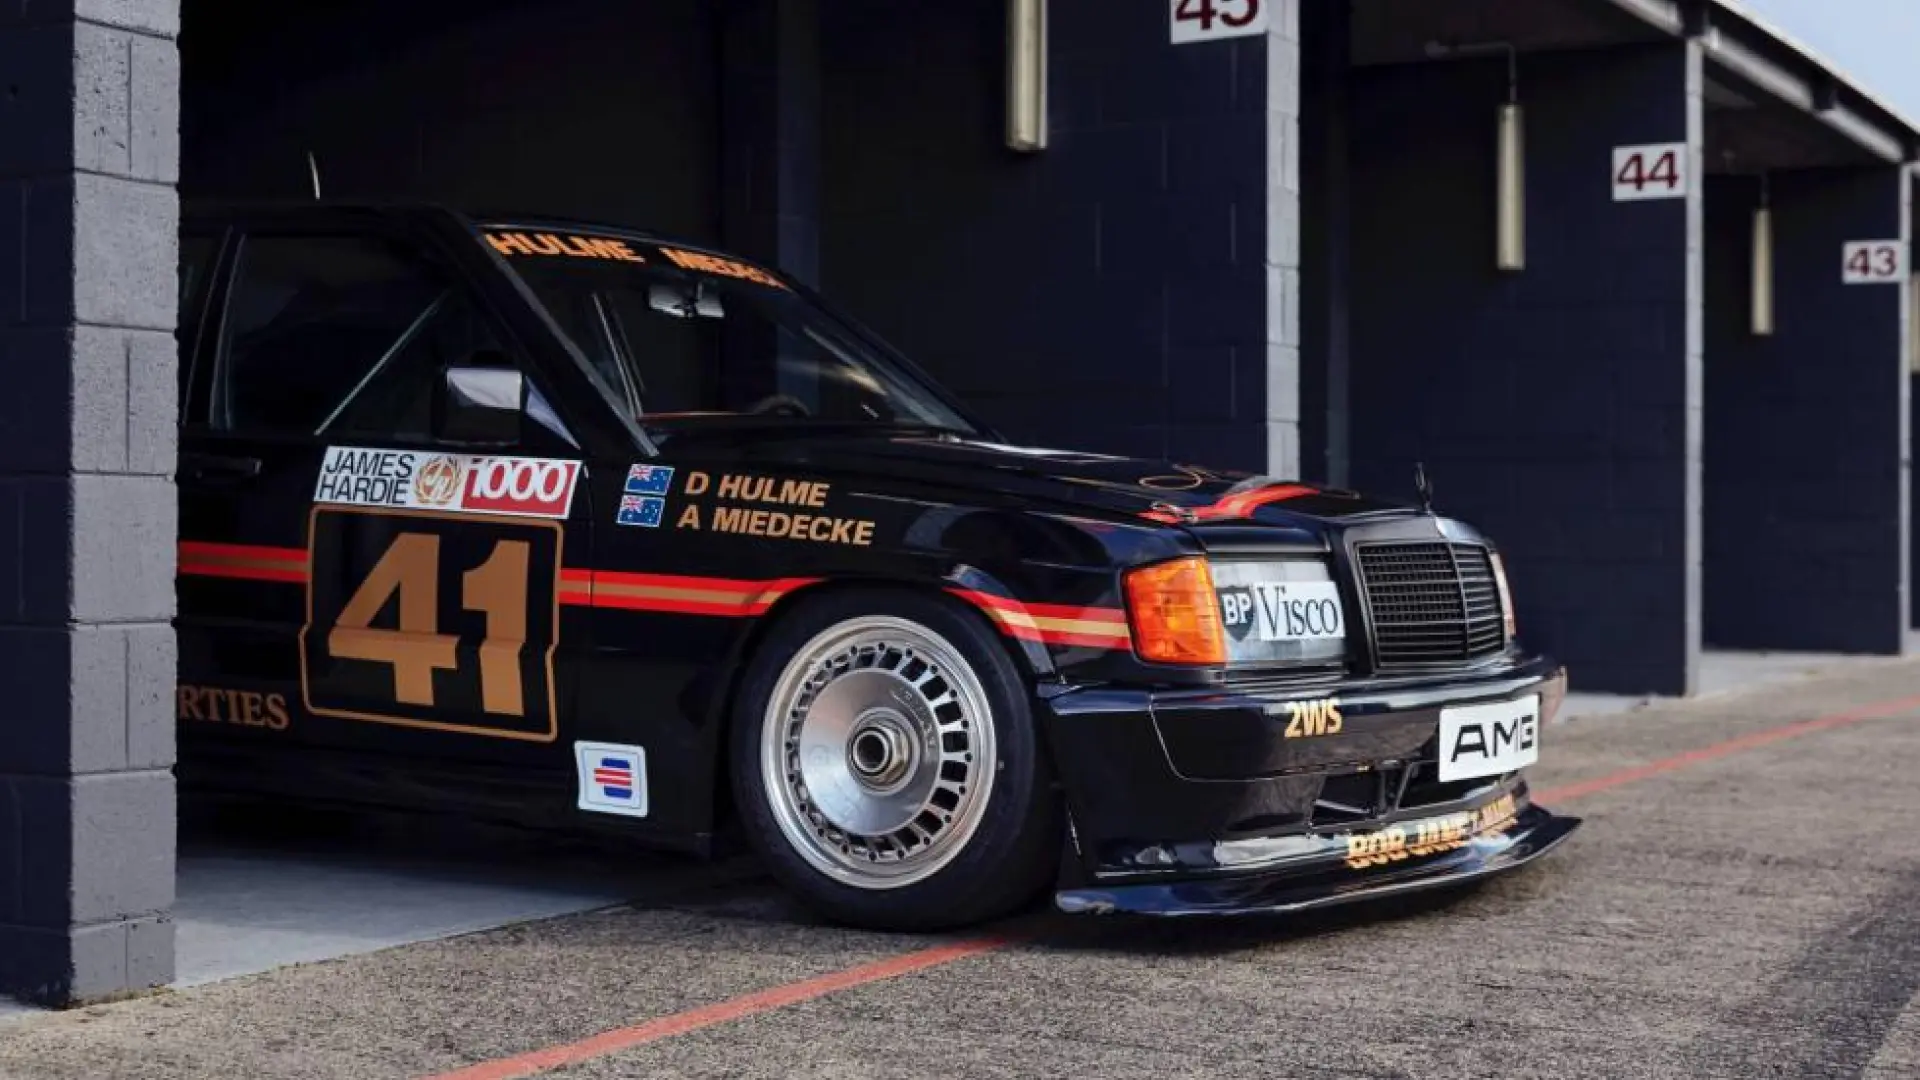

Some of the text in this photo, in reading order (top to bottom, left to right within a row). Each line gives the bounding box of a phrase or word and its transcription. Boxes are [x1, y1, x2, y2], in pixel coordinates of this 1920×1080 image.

[1618, 151, 1679, 191] 44
[484, 232, 644, 263] HULME
[1848, 247, 1896, 276] 43
[325, 450, 414, 478] JAMES
[318, 475, 408, 504] HARDIE
[684, 471, 830, 507] D HULME
[676, 504, 876, 545] A MIEDECKE
[328, 532, 530, 716] 41
[1221, 592, 1252, 625] BP
[1284, 698, 1343, 738] 2WS
